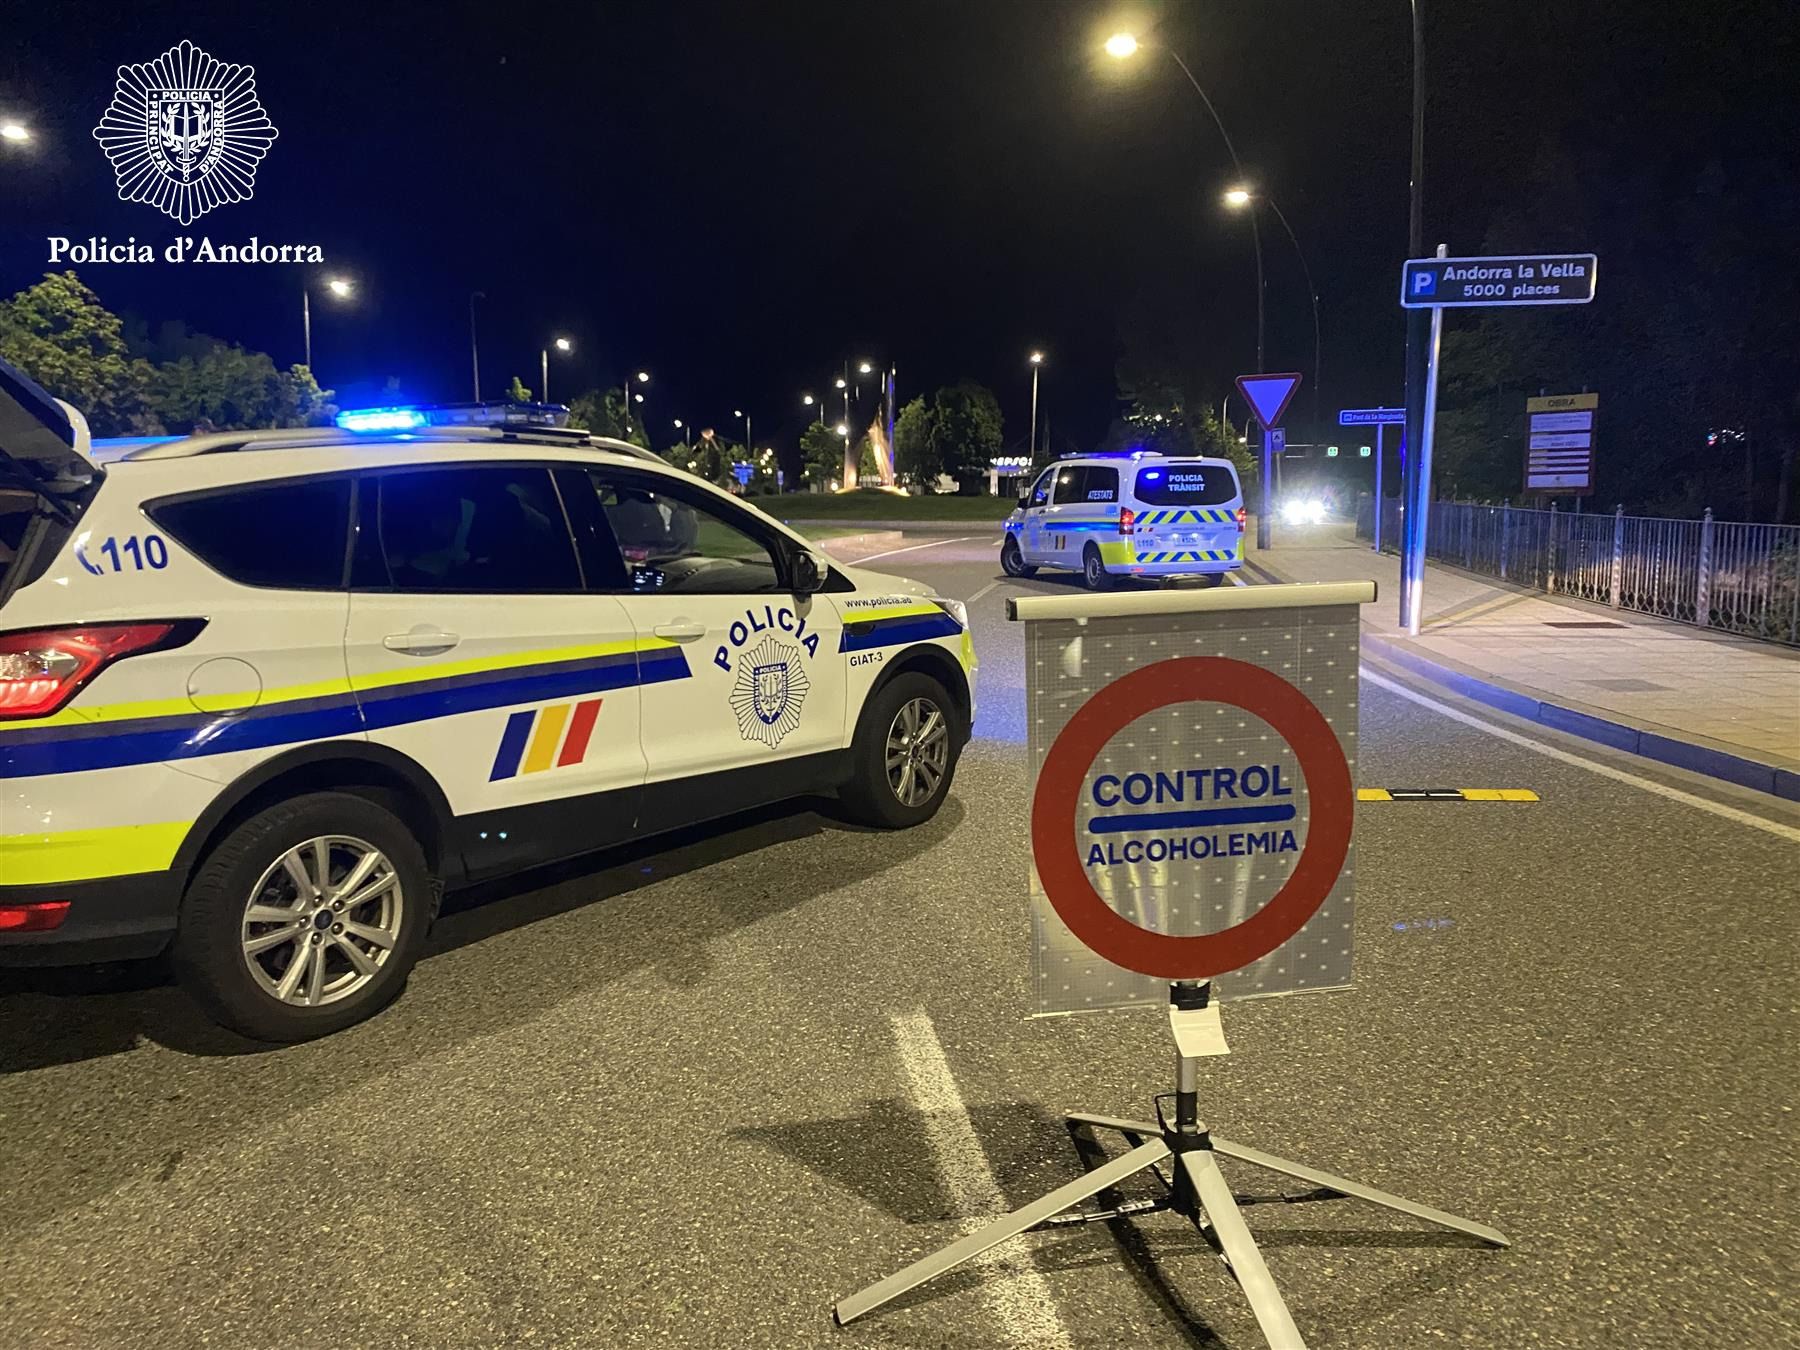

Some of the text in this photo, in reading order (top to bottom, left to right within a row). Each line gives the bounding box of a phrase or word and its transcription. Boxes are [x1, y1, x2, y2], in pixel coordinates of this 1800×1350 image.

[1443, 263, 1585, 281] Andorra la Vella
[1414, 273, 1432, 293] P
[1463, 283, 1560, 298] 5000 places
[1168, 474, 1204, 482] POLICIA
[1168, 482, 1205, 492] TRÀNSIT
[101, 534, 168, 572] 110
[844, 597, 913, 608] www.policia.ad
[714, 605, 820, 672] POLICIA
[850, 651, 883, 667] GIAT-3
[759, 664, 782, 673] POLICIA
[1092, 765, 1292, 807] CONTROL
[1087, 829, 1298, 867] ALCOHOLEMIA
